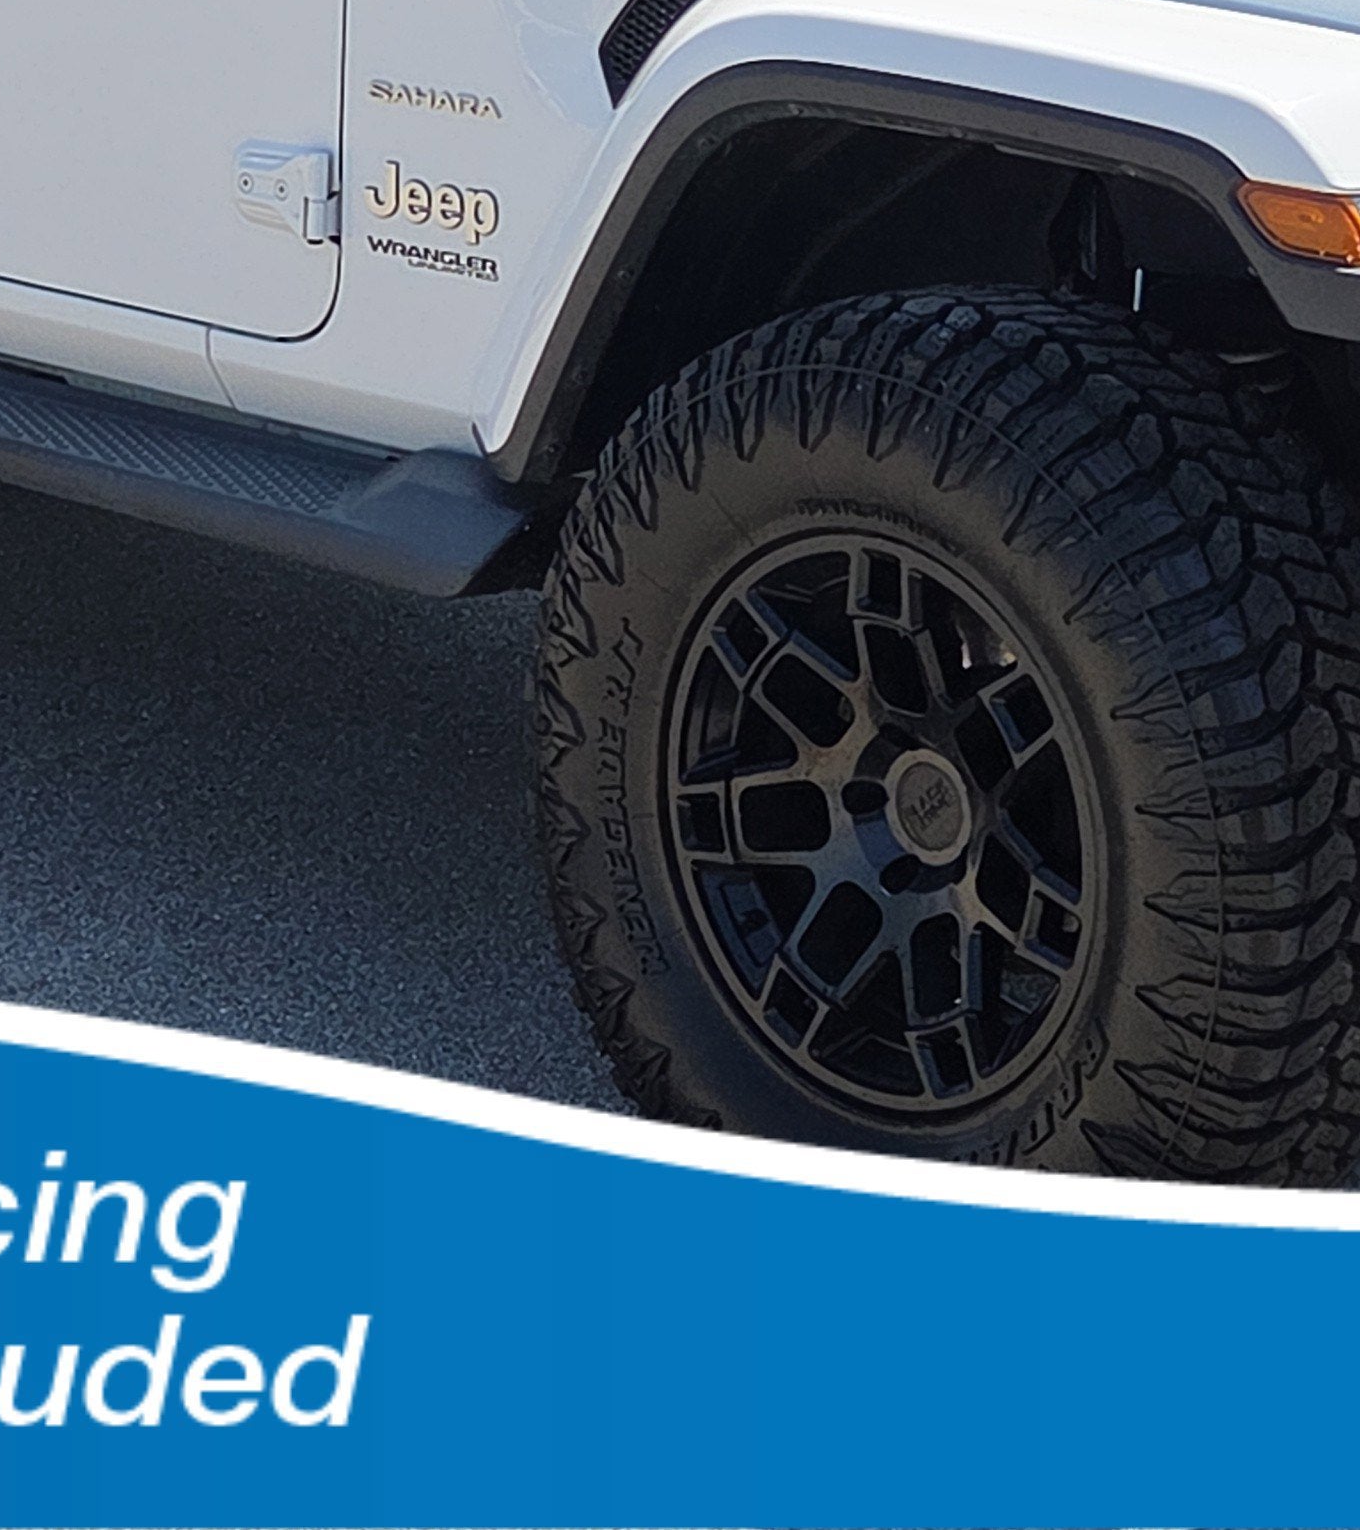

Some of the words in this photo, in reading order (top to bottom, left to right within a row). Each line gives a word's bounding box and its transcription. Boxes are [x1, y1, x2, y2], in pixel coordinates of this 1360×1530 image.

[368, 78, 503, 120] SAHARA
[364, 159, 500, 246] Jeep
[366, 234, 498, 275] WRANGLER
